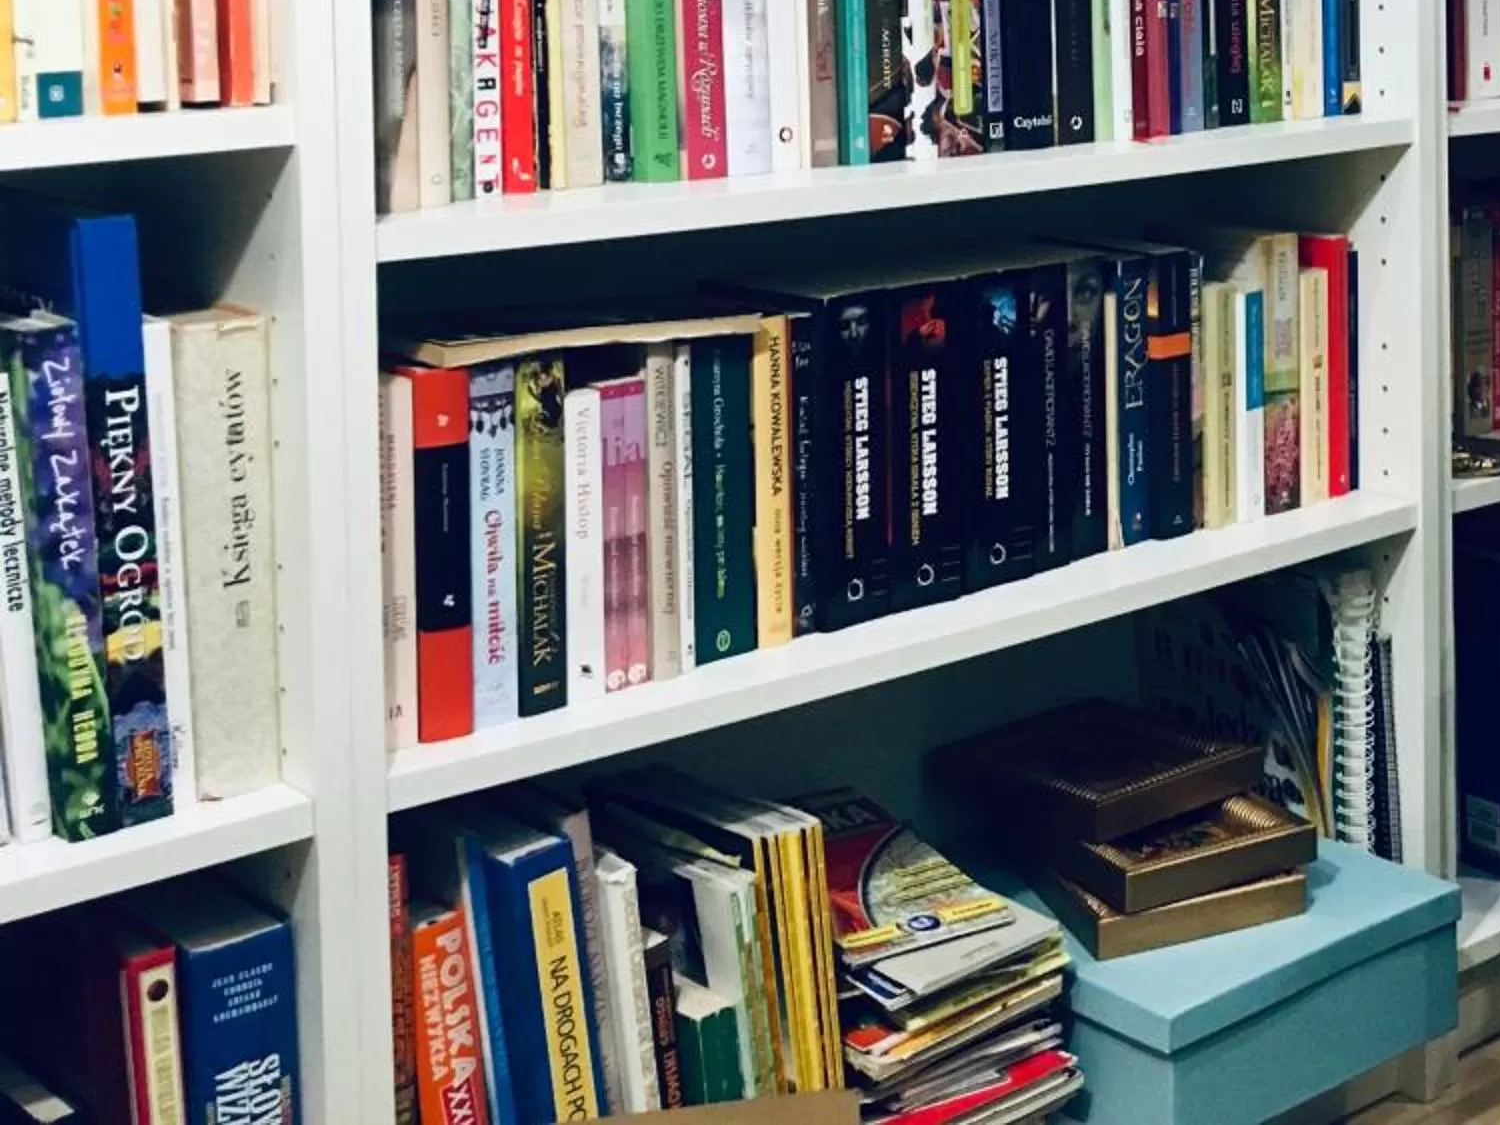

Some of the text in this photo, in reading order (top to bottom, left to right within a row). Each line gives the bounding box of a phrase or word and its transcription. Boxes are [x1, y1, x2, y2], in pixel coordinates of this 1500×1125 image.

[42, 359, 86, 572] Ziołowy Zakątek
[218, 367, 257, 590] Księga cytatów
[769, 392, 785, 497] KOWALEWSKA
[854, 376, 870, 520] STIEG LARSSON
[921, 368, 937, 516] STIEG LARSSON
[994, 356, 1009, 499] STIEG LARSSON
[0, 477, 20, 536] metody
[100, 387, 150, 663] PIĘKNY OGRÓD
[483, 510, 503, 574] Chwila
[4, 542, 27, 612] lecznicze
[531, 540, 559, 667] MICHALAK
[419, 952, 450, 1084] NIEZWYKŁA
[435, 925, 477, 1090] POLSKA
[549, 955, 569, 990] NA
[552, 989, 583, 1095] DROGACH
